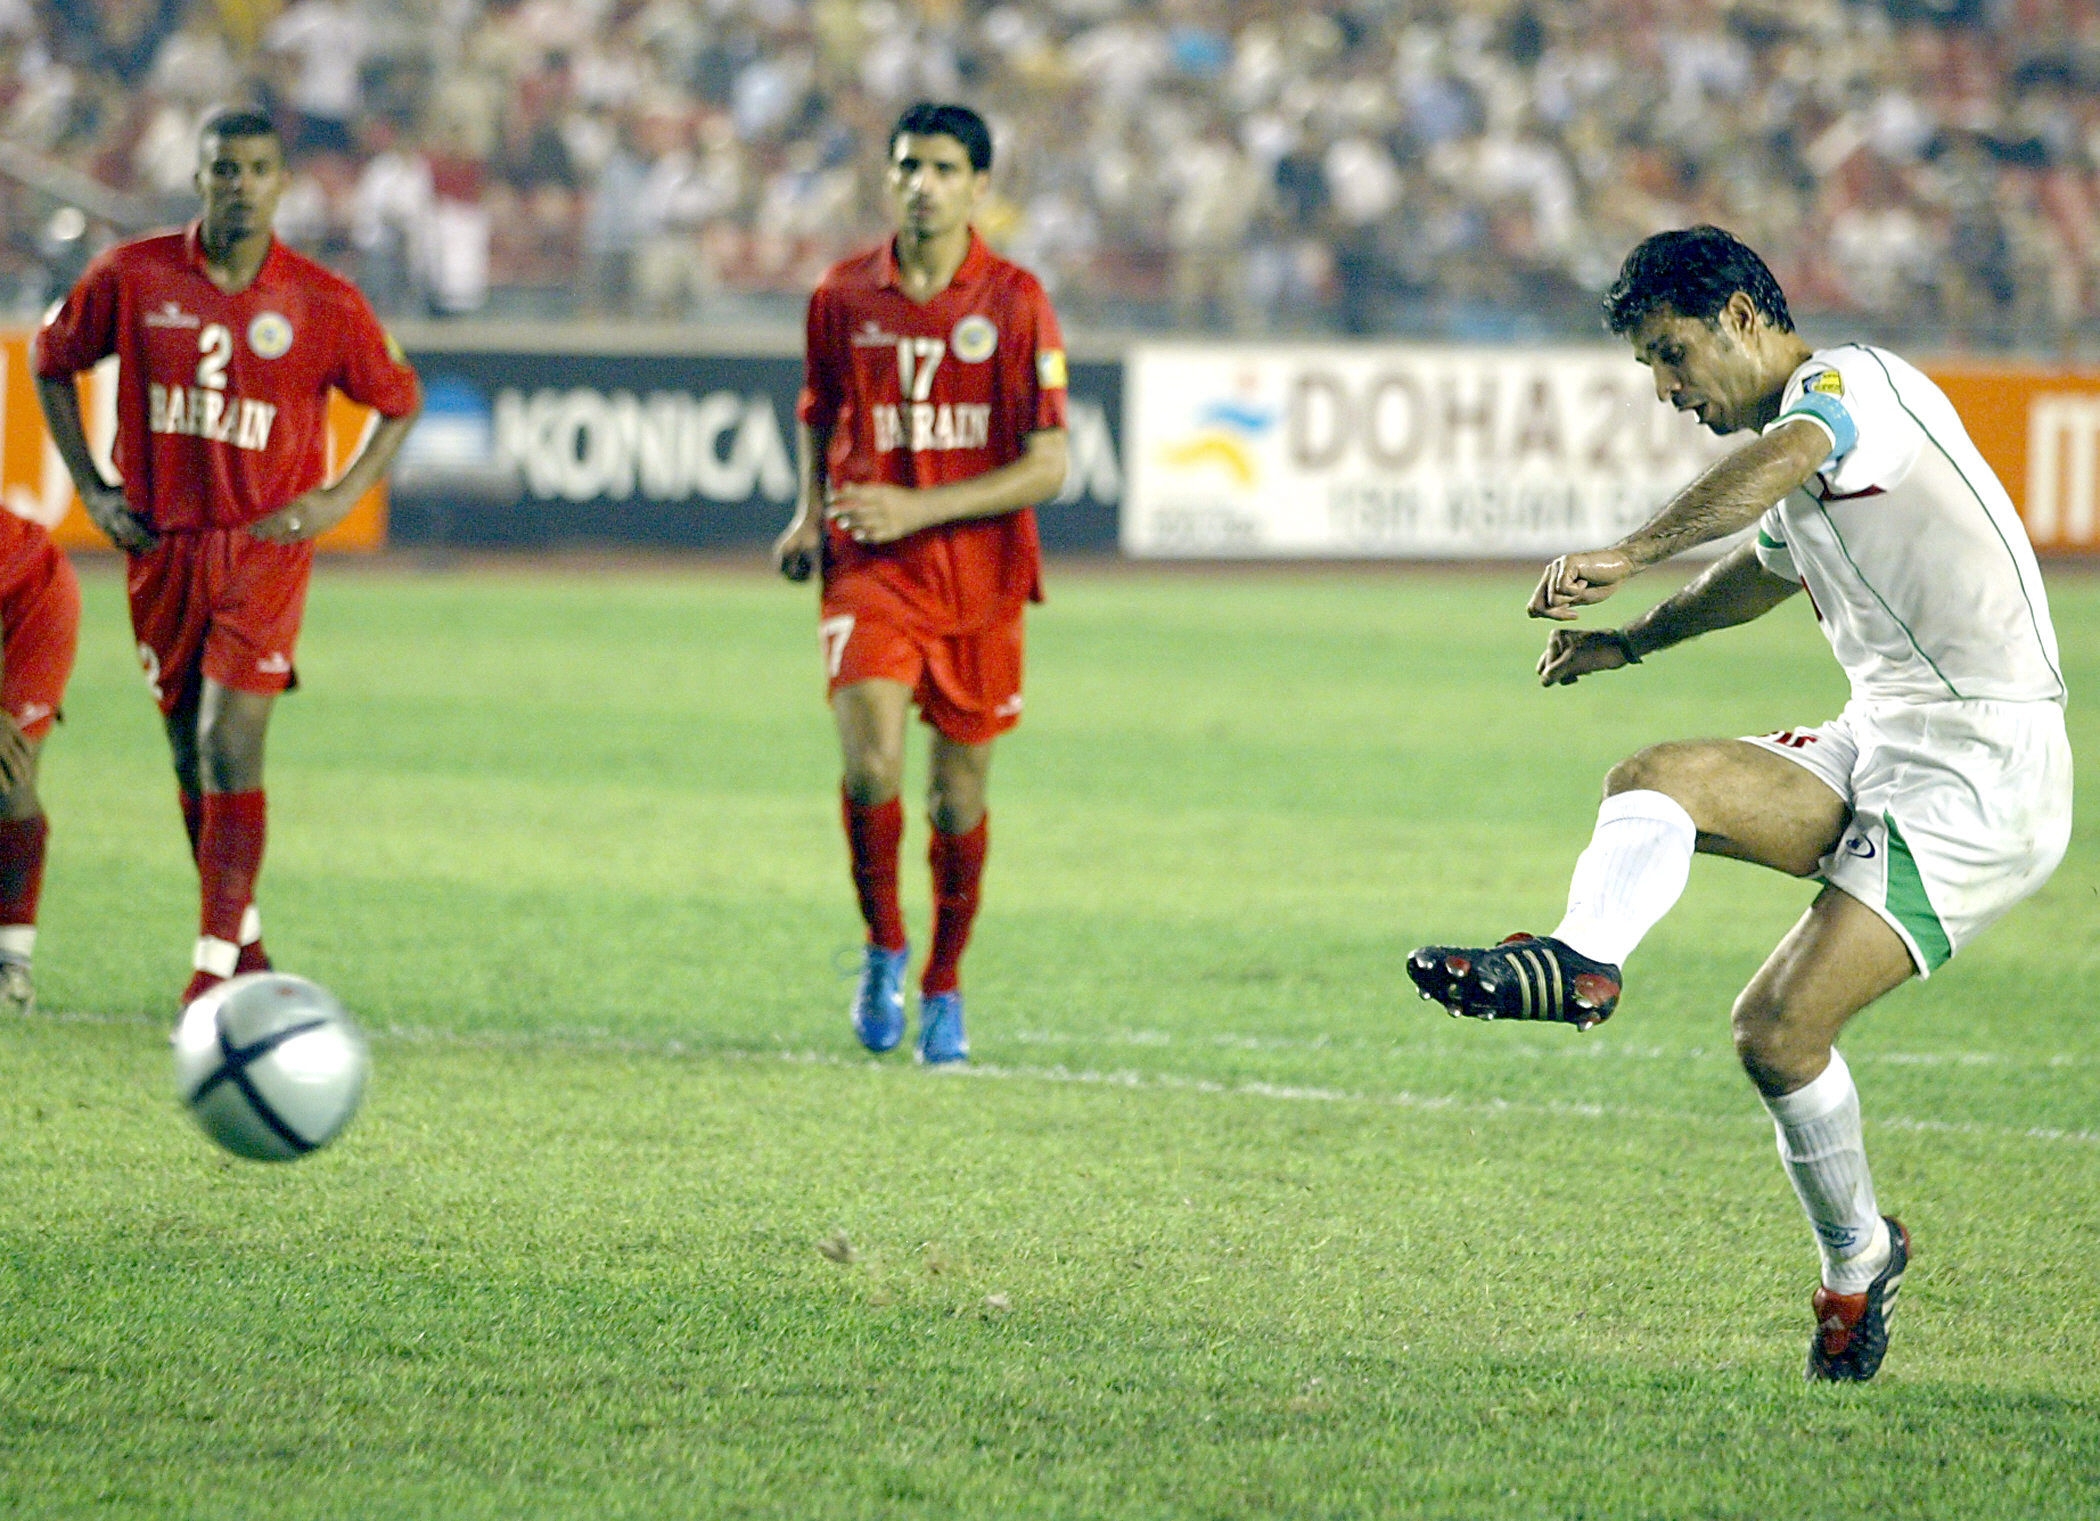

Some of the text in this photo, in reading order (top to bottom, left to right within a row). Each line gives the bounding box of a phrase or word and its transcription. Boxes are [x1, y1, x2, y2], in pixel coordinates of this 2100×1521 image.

[197, 323, 233, 390] 2
[897, 336, 946, 401] 17
[149, 382, 277, 451] BAHRAIN
[493, 388, 798, 500] KONICA
